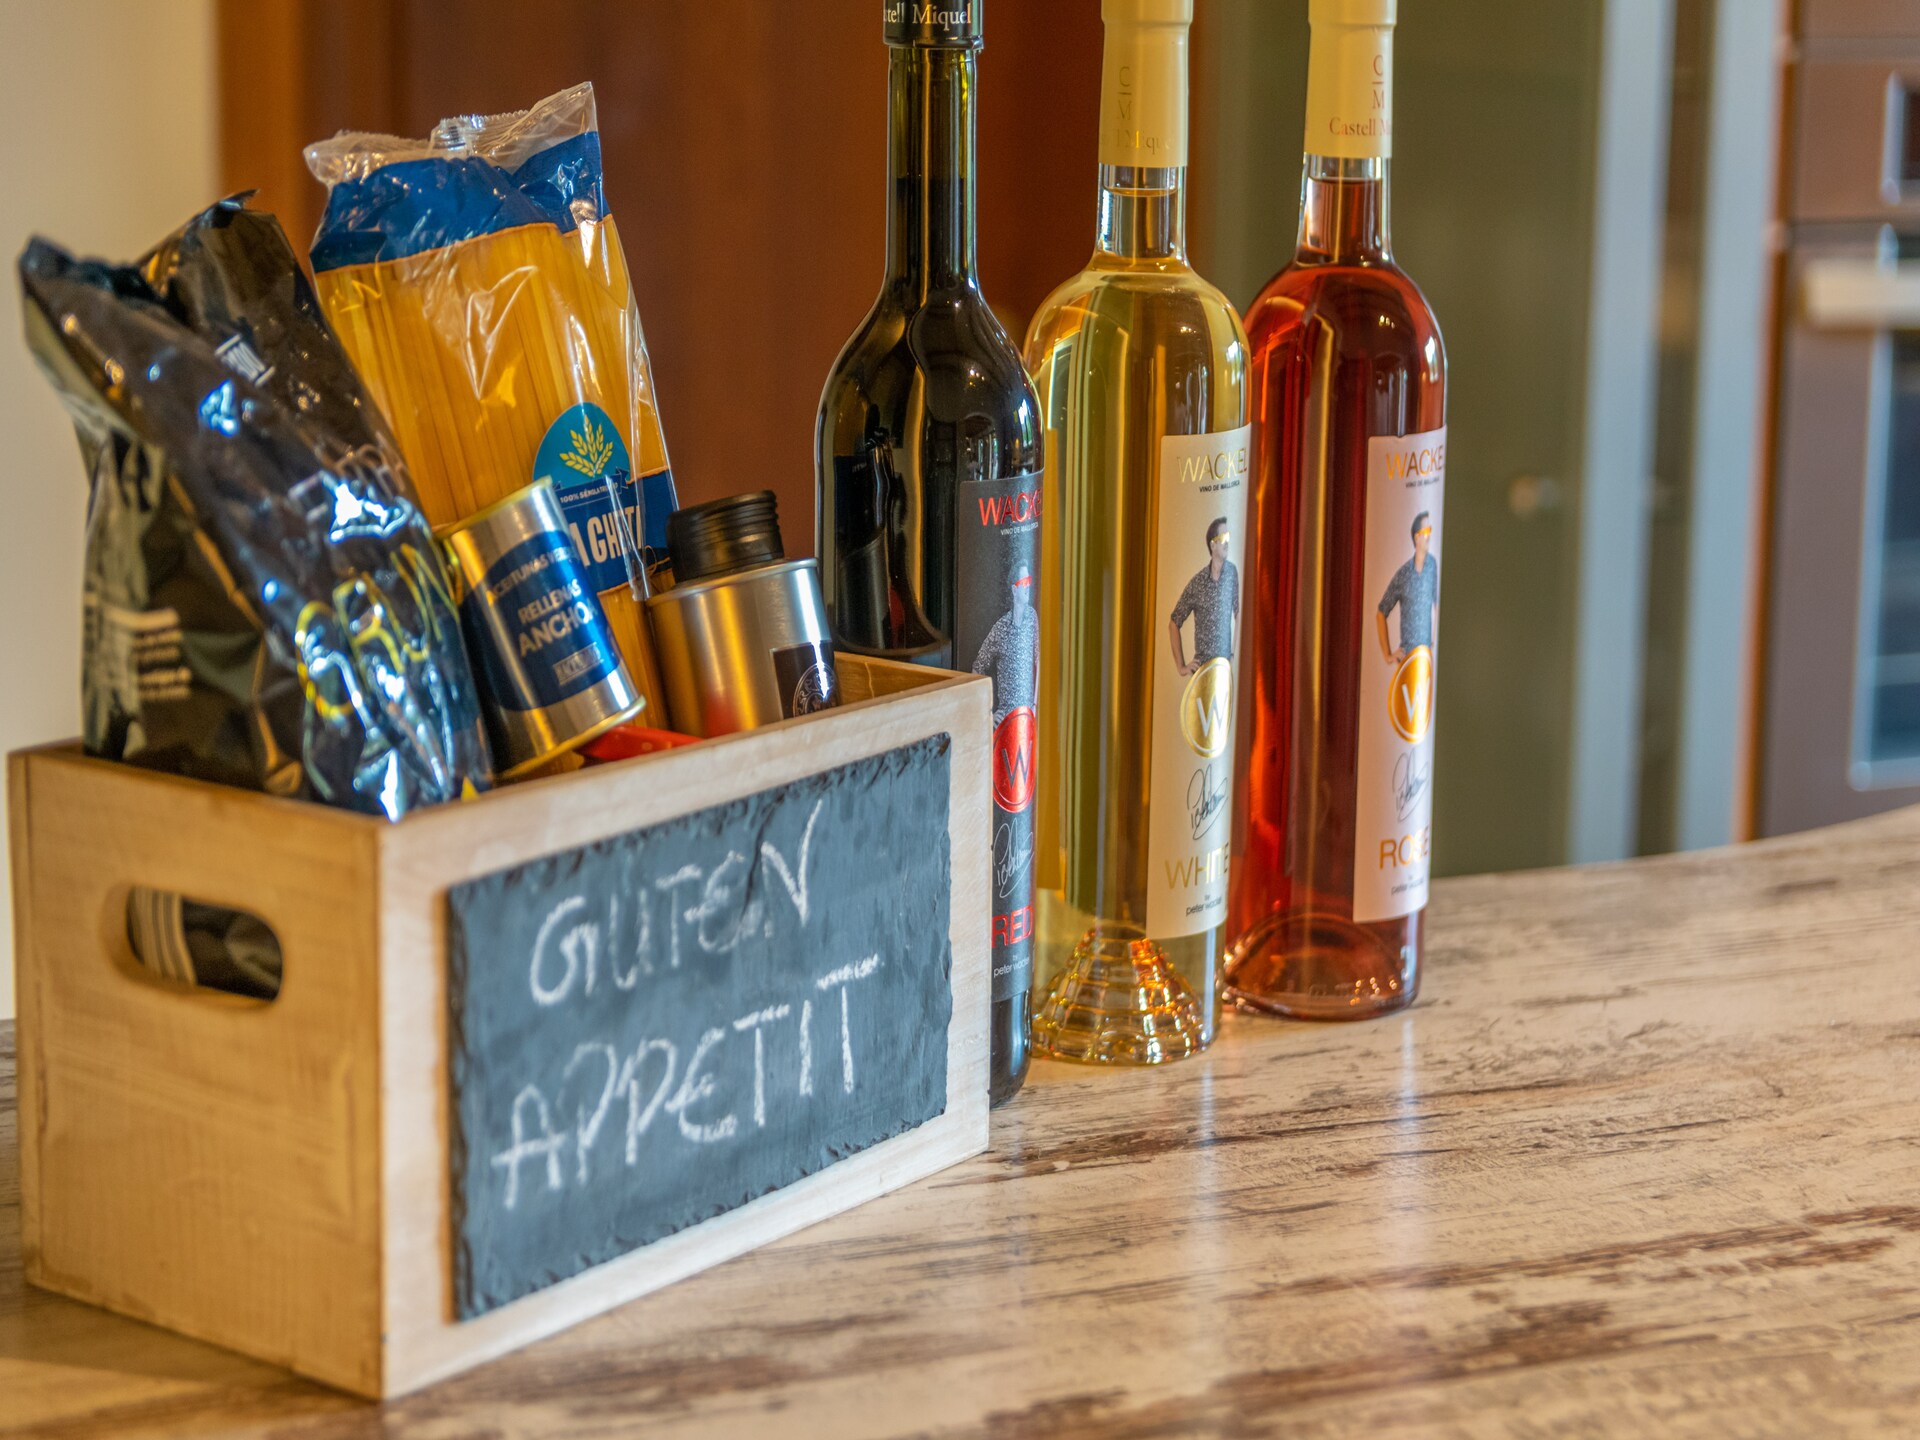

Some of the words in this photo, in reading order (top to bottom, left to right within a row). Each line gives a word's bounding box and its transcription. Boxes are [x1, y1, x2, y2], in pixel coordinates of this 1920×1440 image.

[912, 2, 972, 31] Miquel
[1373, 54, 1384, 77] C
[1328, 115, 1377, 137] Castell
[1199, 485, 1212, 493] VINO
[1213, 484, 1220, 492] DE
[1196, 693, 1228, 737] W
[1002, 740, 1032, 789] W
[1165, 842, 1229, 890] WHITE
[530, 799, 823, 1006] GUTEN
[992, 905, 1034, 948] RED
[491, 952, 884, 1210] APPETIT
